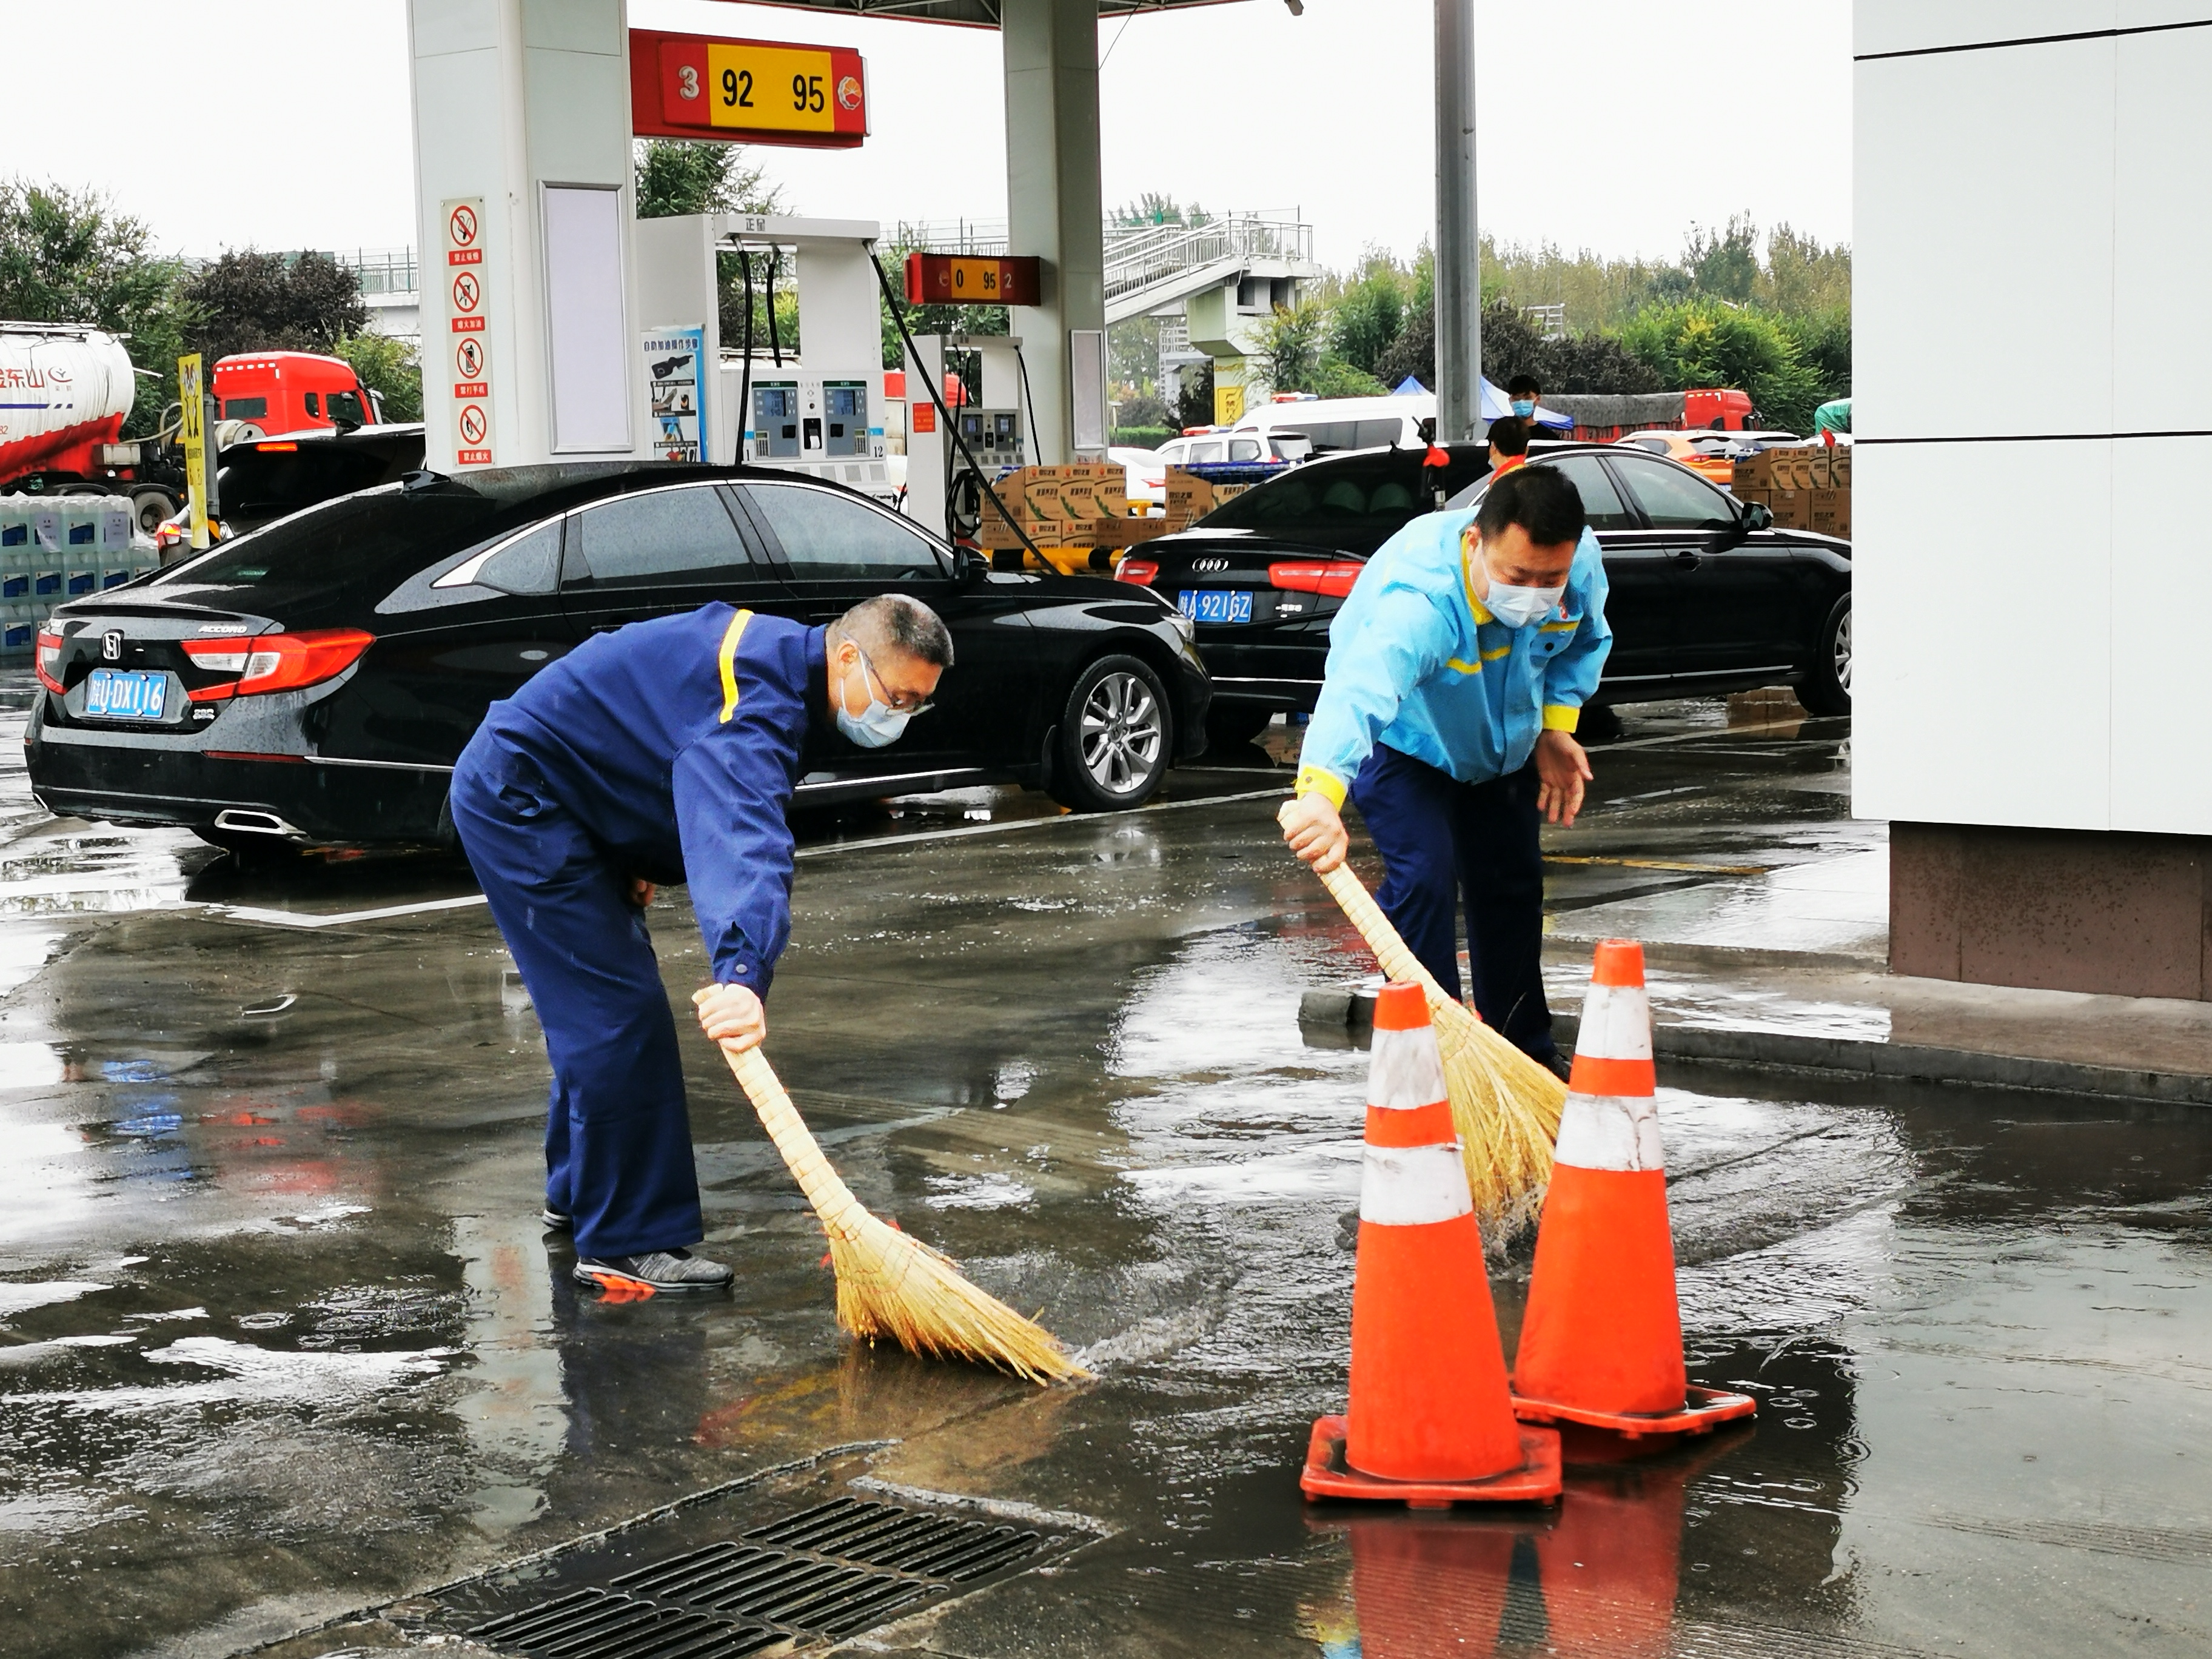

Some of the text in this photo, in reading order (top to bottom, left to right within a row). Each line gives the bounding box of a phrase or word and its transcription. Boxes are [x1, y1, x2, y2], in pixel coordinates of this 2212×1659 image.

[679, 65, 825, 113] 3 92 95
[956, 269, 1012, 290] 0 95 2
[874, 446, 883, 458] 12
[198, 625, 247, 634] ACCORD
